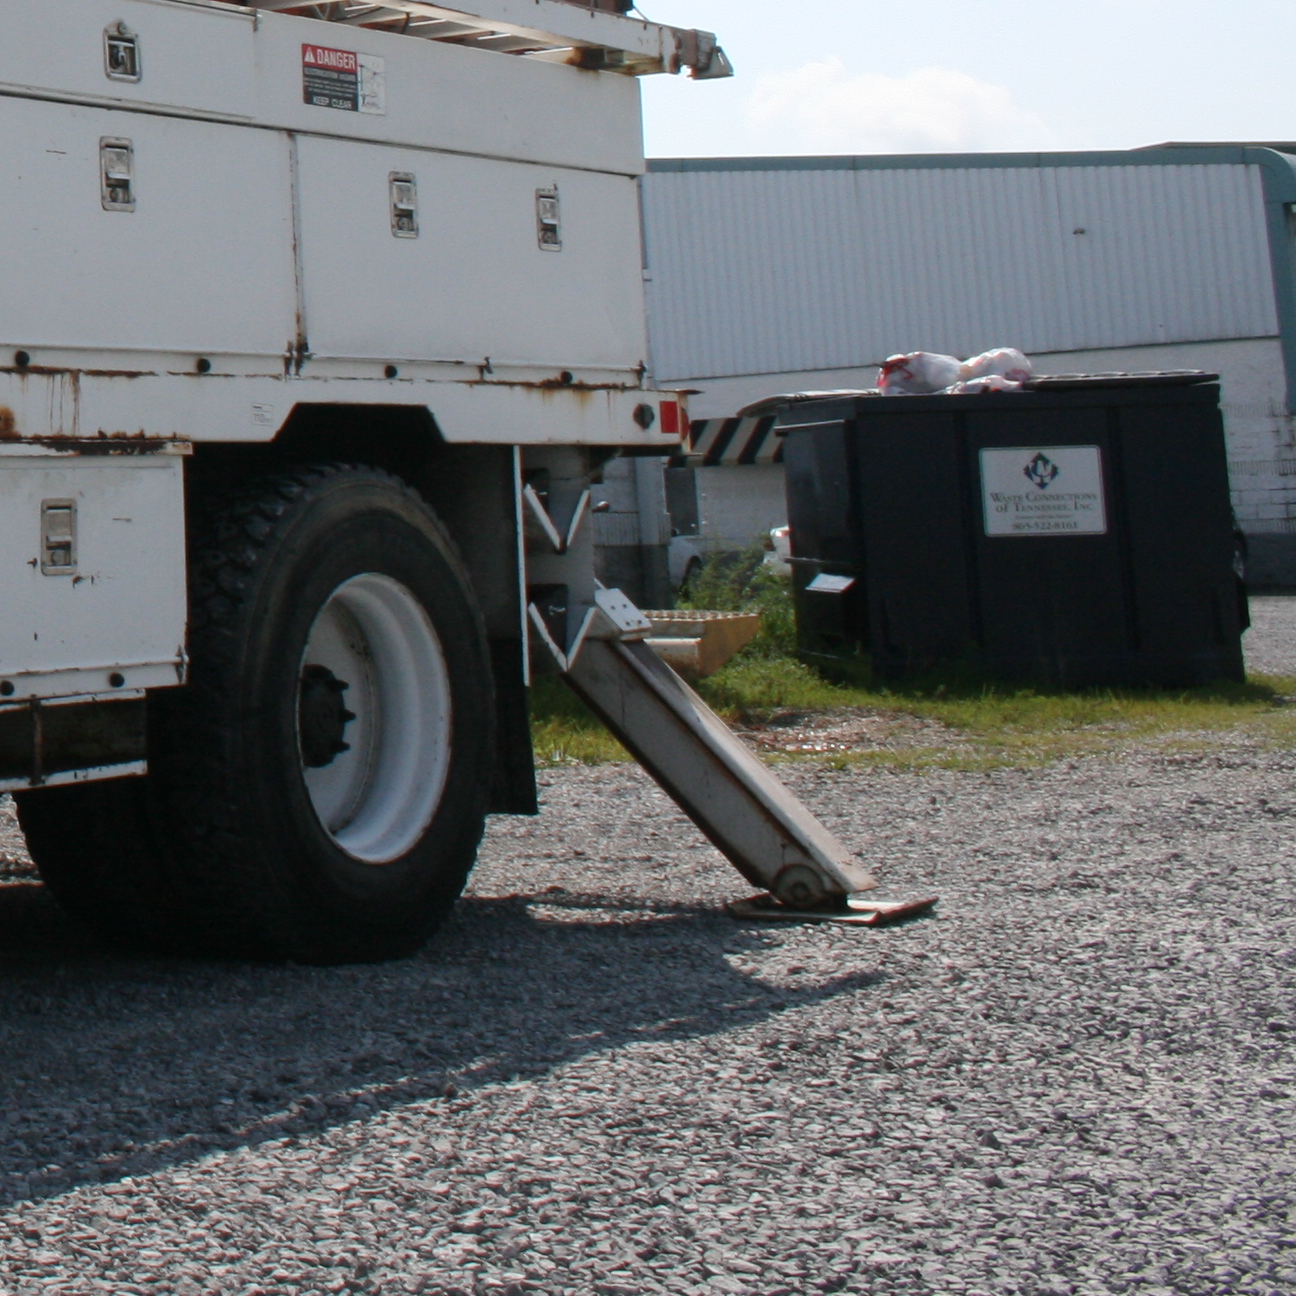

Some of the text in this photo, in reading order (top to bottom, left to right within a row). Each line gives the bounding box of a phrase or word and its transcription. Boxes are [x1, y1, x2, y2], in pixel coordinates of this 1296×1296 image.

[316, 48, 356, 70] DANGER
[312, 95, 352, 110] KEEP CLEAR
